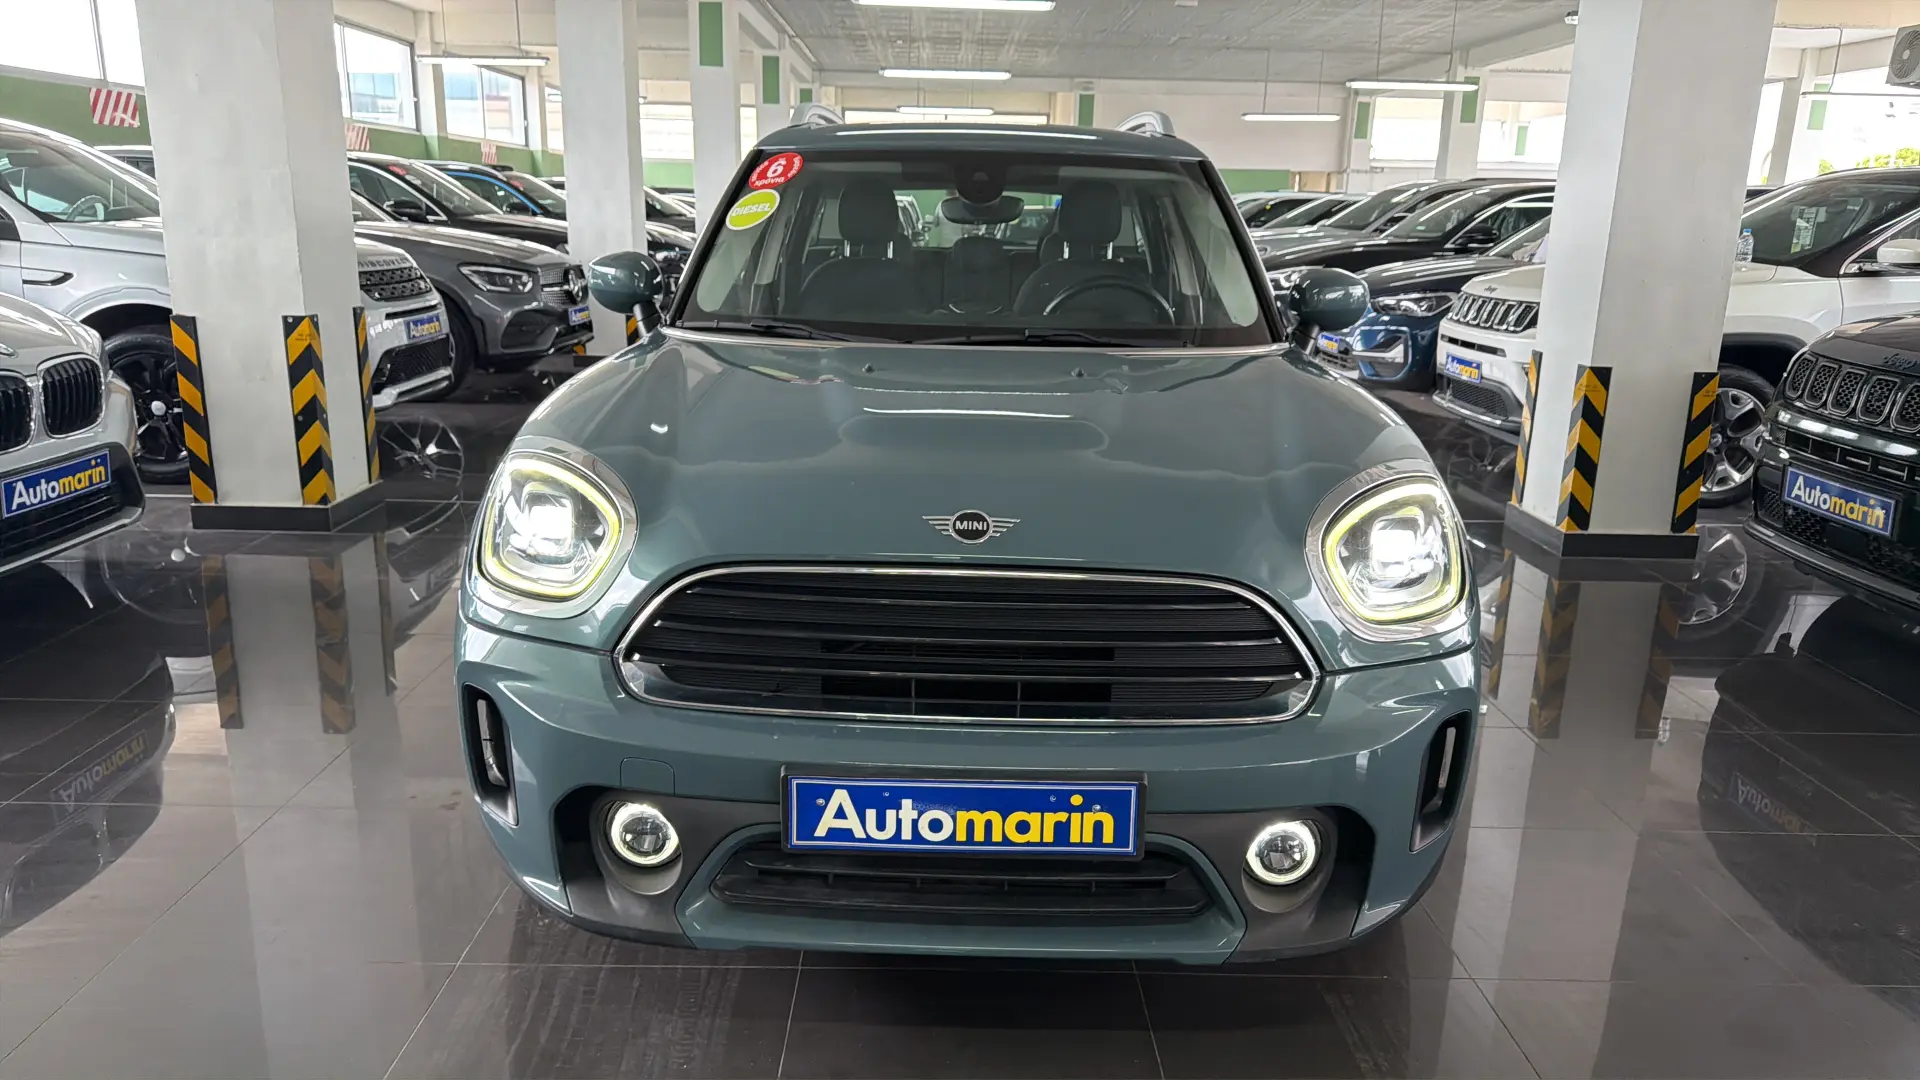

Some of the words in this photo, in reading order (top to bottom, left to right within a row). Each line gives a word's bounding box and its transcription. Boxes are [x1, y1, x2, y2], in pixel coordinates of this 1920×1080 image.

[767, 157, 786, 178] 6
[731, 202, 771, 217] DIESEL
[11, 459, 105, 511] Automarin
[1791, 475, 1886, 529] Automarin
[955, 520, 987, 531] MINI
[813, 788, 1115, 844] Automarin
